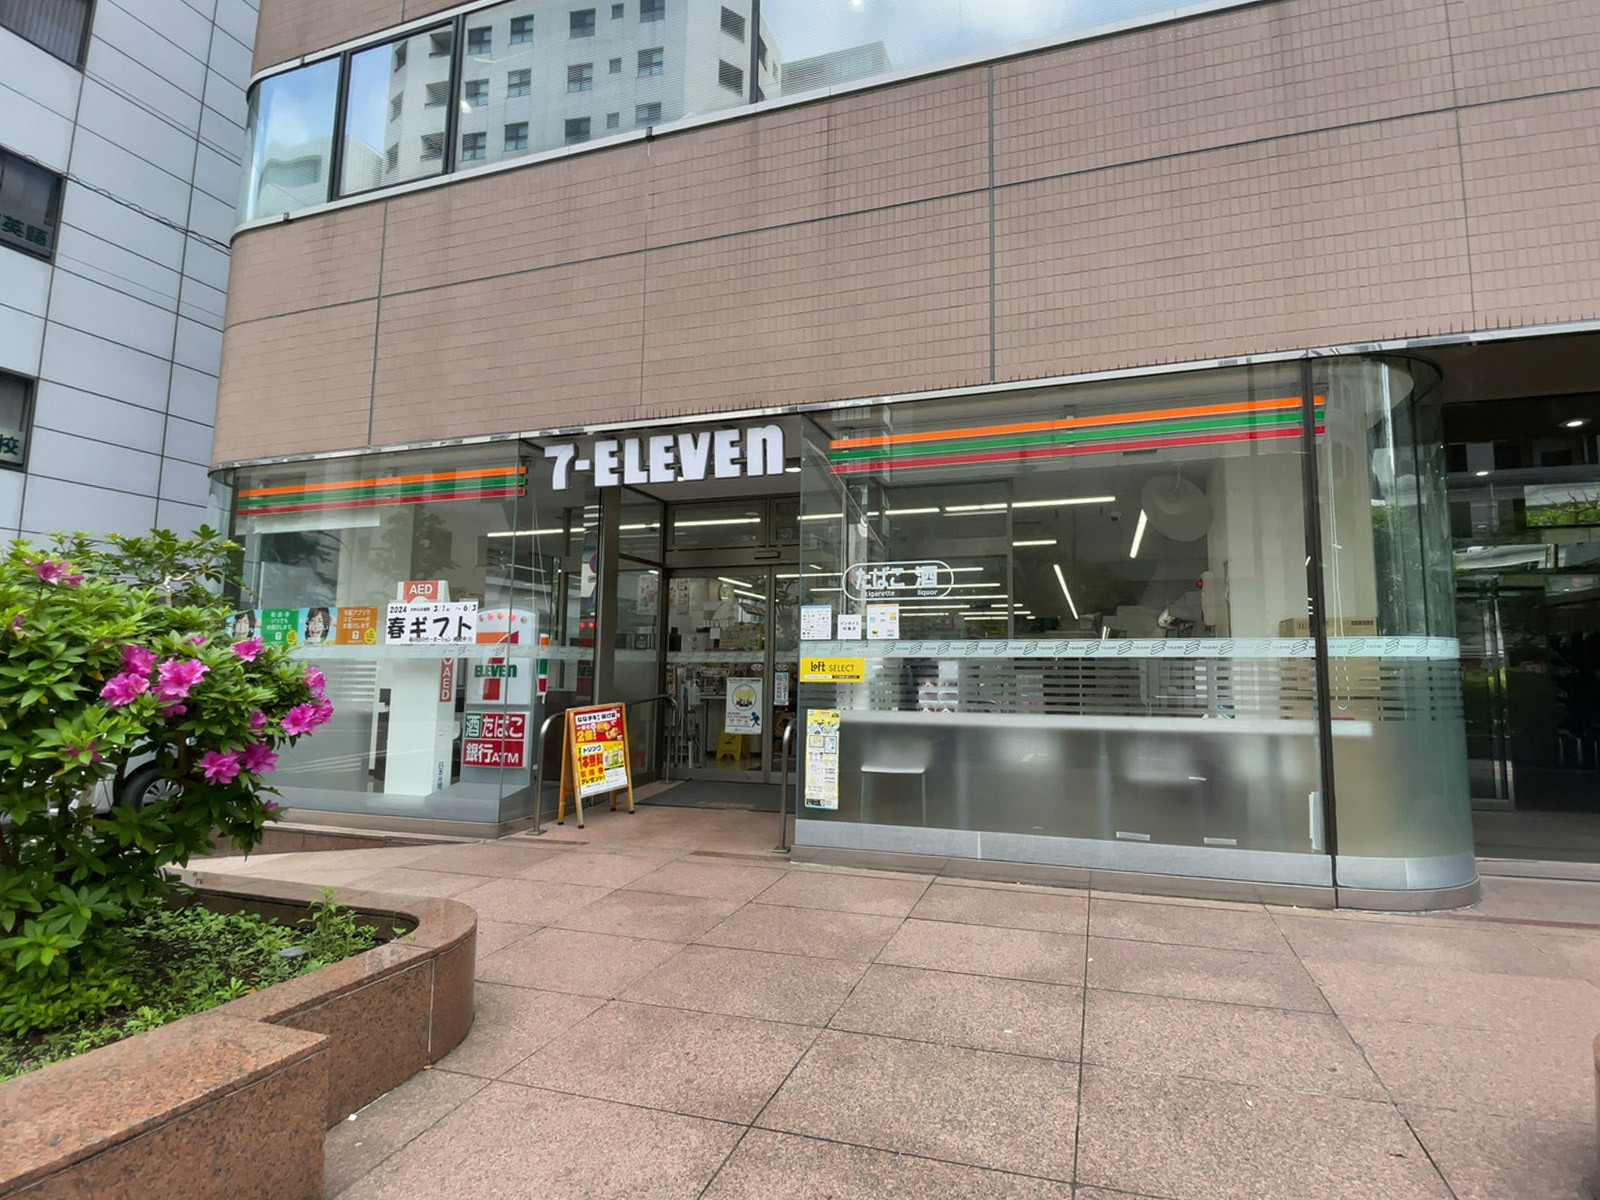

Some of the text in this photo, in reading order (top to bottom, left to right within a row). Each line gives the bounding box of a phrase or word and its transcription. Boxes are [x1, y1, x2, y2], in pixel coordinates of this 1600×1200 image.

[409, 583, 433, 595] AED
[855, 566, 905, 590] たばこ
[387, 616, 472, 639] 春ギフト
[829, 664, 855, 672] SELECT
[441, 666, 452, 700] AED
[465, 715, 525, 738] 酒 たばこ
[465, 742, 520, 763] 銀行ATM
